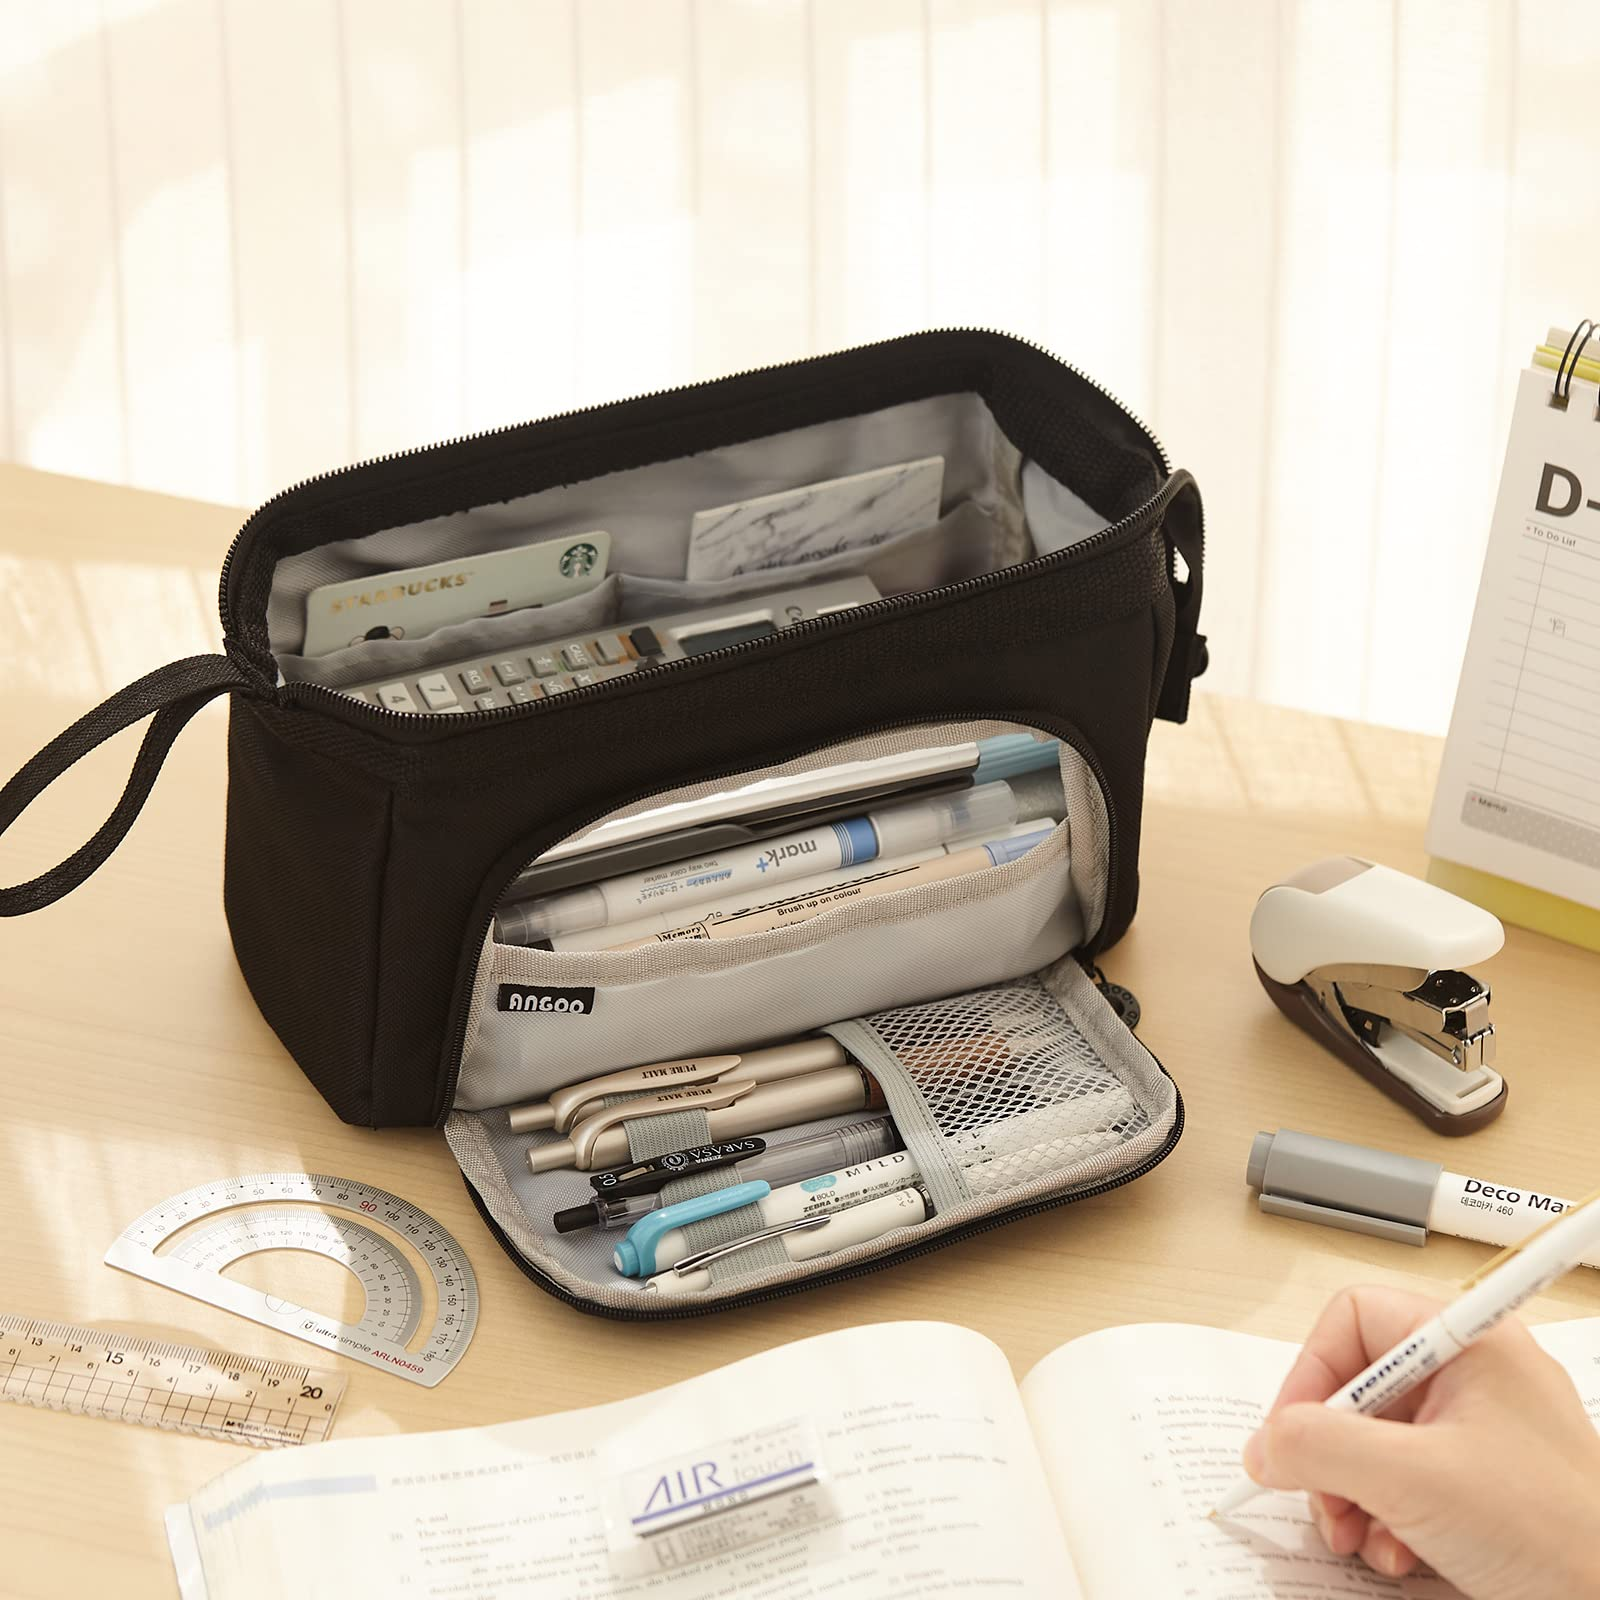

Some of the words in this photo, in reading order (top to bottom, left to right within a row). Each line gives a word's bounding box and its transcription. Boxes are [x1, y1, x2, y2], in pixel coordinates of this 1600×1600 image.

[1533, 527, 1544, 537] To
[1546, 531, 1560, 543] Do
[1561, 536, 1577, 548] List
[330, 573, 467, 614] STARBUCKS
[569, 644, 586, 664] CALC
[467, 670, 481, 686] RCL
[429, 684, 446, 694] 7
[391, 696, 406, 704] 4
[643, 873, 669, 884] marker
[670, 868, 687, 878] color
[776, 901, 804, 917] Brush
[806, 899, 818, 910] up
[820, 897, 831, 906] on
[833, 887, 862, 901] colour
[661, 926, 702, 942] Memory
[509, 993, 585, 1014] ANGOO
[641, 1069, 668, 1080] MALT
[670, 1064, 697, 1075] PURE
[657, 1092, 683, 1103] MALT
[684, 1088, 712, 1099] PURE
[689, 1140, 755, 1159] SARASA
[846, 1154, 905, 1178] MILD
[598, 1173, 617, 1187] 0.5
[225, 1193, 237, 1201] 40
[253, 1188, 264, 1196] 50
[311, 1188, 322, 1197] 70
[336, 1193, 349, 1201] 80
[816, 1190, 836, 1201] BOLD
[1464, 1180, 1520, 1203] Deco
[200, 1201, 211, 1209] 30
[359, 1200, 377, 1213] 90
[803, 1200, 832, 1213] ZEBRA
[1460, 1196, 1493, 1213] 데코마카
[1496, 1205, 1514, 1216] 460
[175, 1211, 187, 1220] 20
[385, 1210, 400, 1222] 100
[154, 1225, 165, 1233] 10
[405, 1223, 419, 1235] 110
[246, 1232, 259, 1240] 140
[315, 1233, 328, 1241] 100
[422, 1239, 436, 1251] 120
[435, 1256, 447, 1269] 130
[444, 1274, 454, 1287] 140
[448, 1294, 457, 1306] 150
[444, 1313, 455, 1326] 160
[436, 1332, 448, 1345] 170
[315, 1327, 372, 1353] ultra-simple
[372, 1350, 425, 1375] ARLN0459
[423, 1350, 437, 1362] 180
[9, 1348, 16, 1356] 8
[48, 1355, 56, 1363] 7
[87, 1361, 94, 1369] 6
[127, 1369, 134, 1377] 5
[205, 1383, 213, 1391] 3
[245, 1390, 253, 1398] 2
[31, 1337, 43, 1347] 13
[70, 1344, 82, 1353] 14
[105, 1351, 124, 1365] 15
[149, 1358, 161, 1367] 16
[187, 1364, 201, 1374] 17
[228, 1372, 241, 1382] 18
[267, 1378, 280, 1388] 19
[300, 1385, 323, 1400] 20
[1351, 1344, 1417, 1402] penco
[645, 1461, 723, 1512] AIR
[733, 1450, 802, 1481] touch
